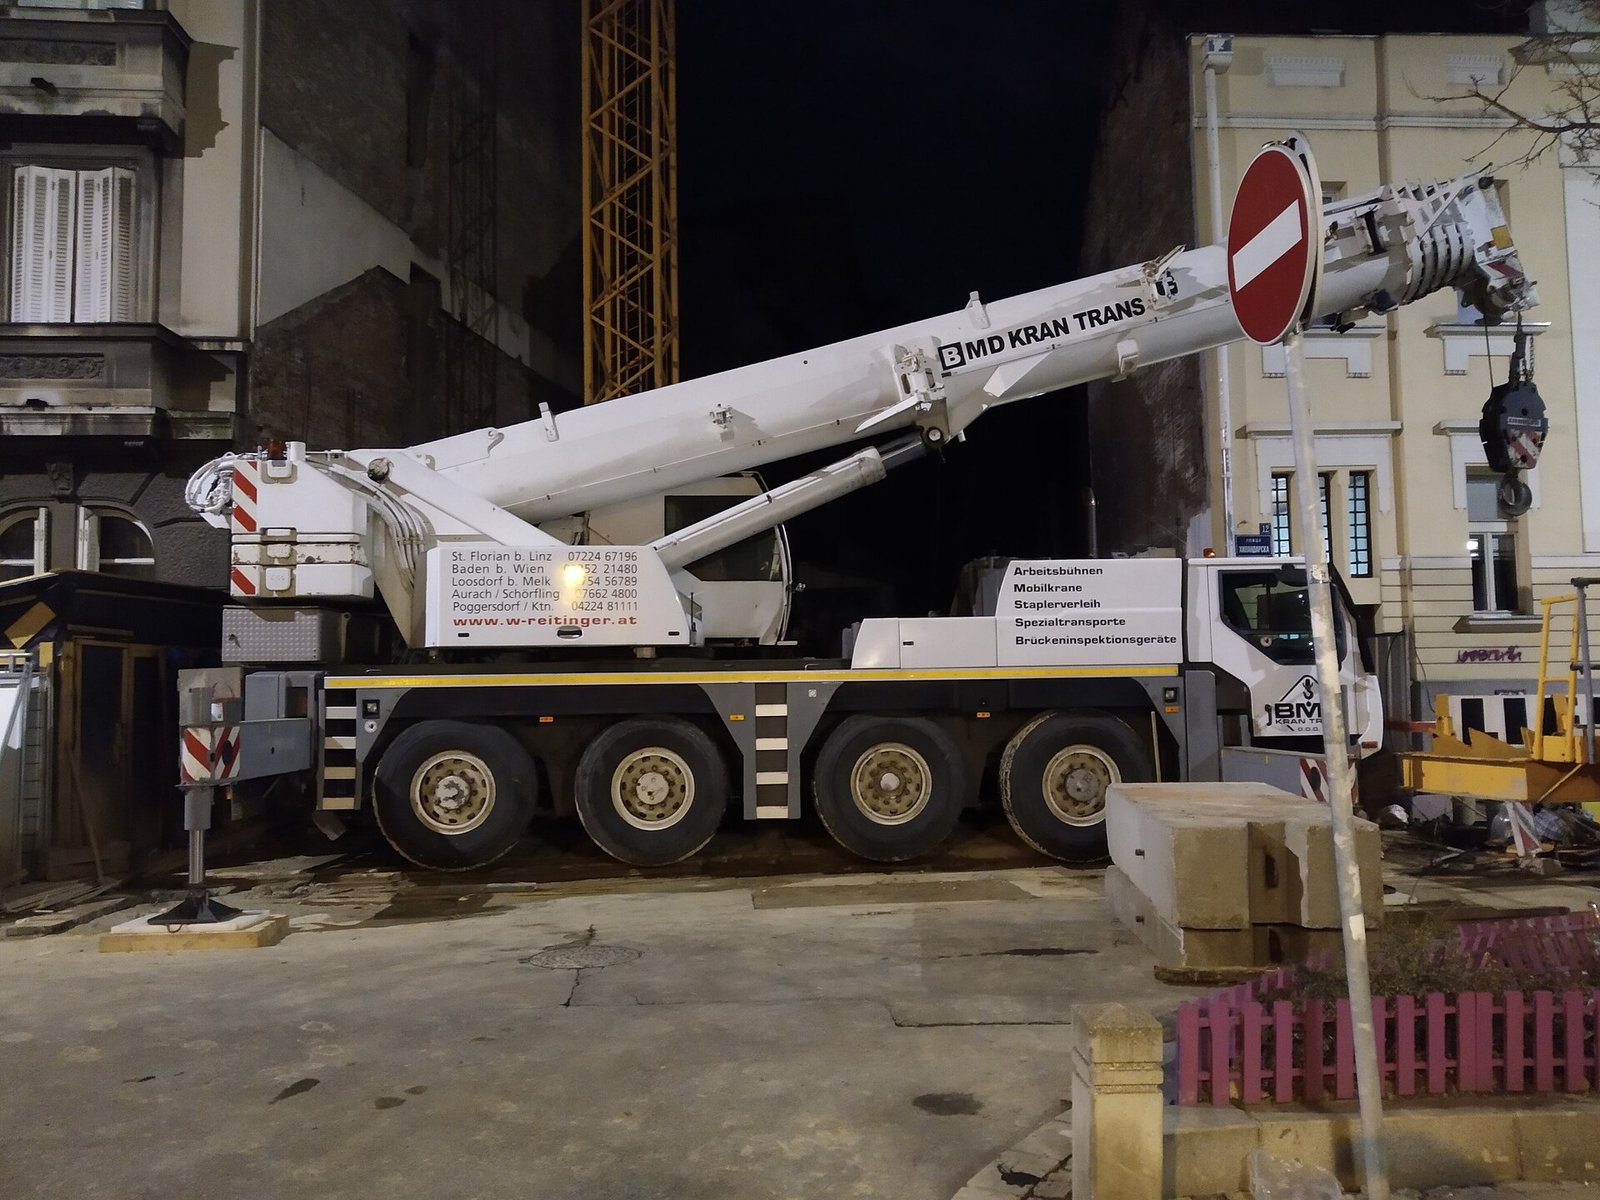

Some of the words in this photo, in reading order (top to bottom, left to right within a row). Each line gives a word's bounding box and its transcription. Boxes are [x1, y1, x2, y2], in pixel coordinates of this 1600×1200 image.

[1008, 317, 1071, 349] KRAN
[1073, 297, 1146, 331] TRANS
[451, 551, 466, 562] St.
[470, 550, 511, 562] Florian
[514, 550, 525, 562] b.
[529, 550, 553, 562] Linz
[567, 551, 602, 562] 07224
[604, 551, 638, 562] 67196
[451, 564, 490, 574] Baden
[495, 563, 507, 574] b.
[512, 563, 545, 574] Wien
[603, 563, 638, 575] 21480
[1013, 566, 1104, 577] Arbeitsbühnen
[451, 575, 504, 587] Loosdorf
[507, 575, 518, 587] b.
[522, 576, 551, 587] Melk
[604, 576, 638, 587] 56789
[1013, 583, 1083, 593] Mobilkrane
[451, 588, 492, 600] Aurach
[495, 589, 500, 600] /
[502, 588, 560, 601] Schörfling
[611, 588, 638, 599] 4800
[453, 601, 521, 615] Poggersdorf
[523, 602, 529, 612] /
[531, 602, 554, 612] Ktn.
[571, 601, 604, 612] 04224
[606, 601, 639, 612] 81111
[1014, 599, 1101, 611] Staplerverleih
[453, 614, 638, 627] www.w-reitinger.at
[1015, 617, 1126, 630] Spezialtransporte
[1015, 635, 1177, 647] Brückeninspektionsgeräte
[1274, 703, 1322, 718] BM
